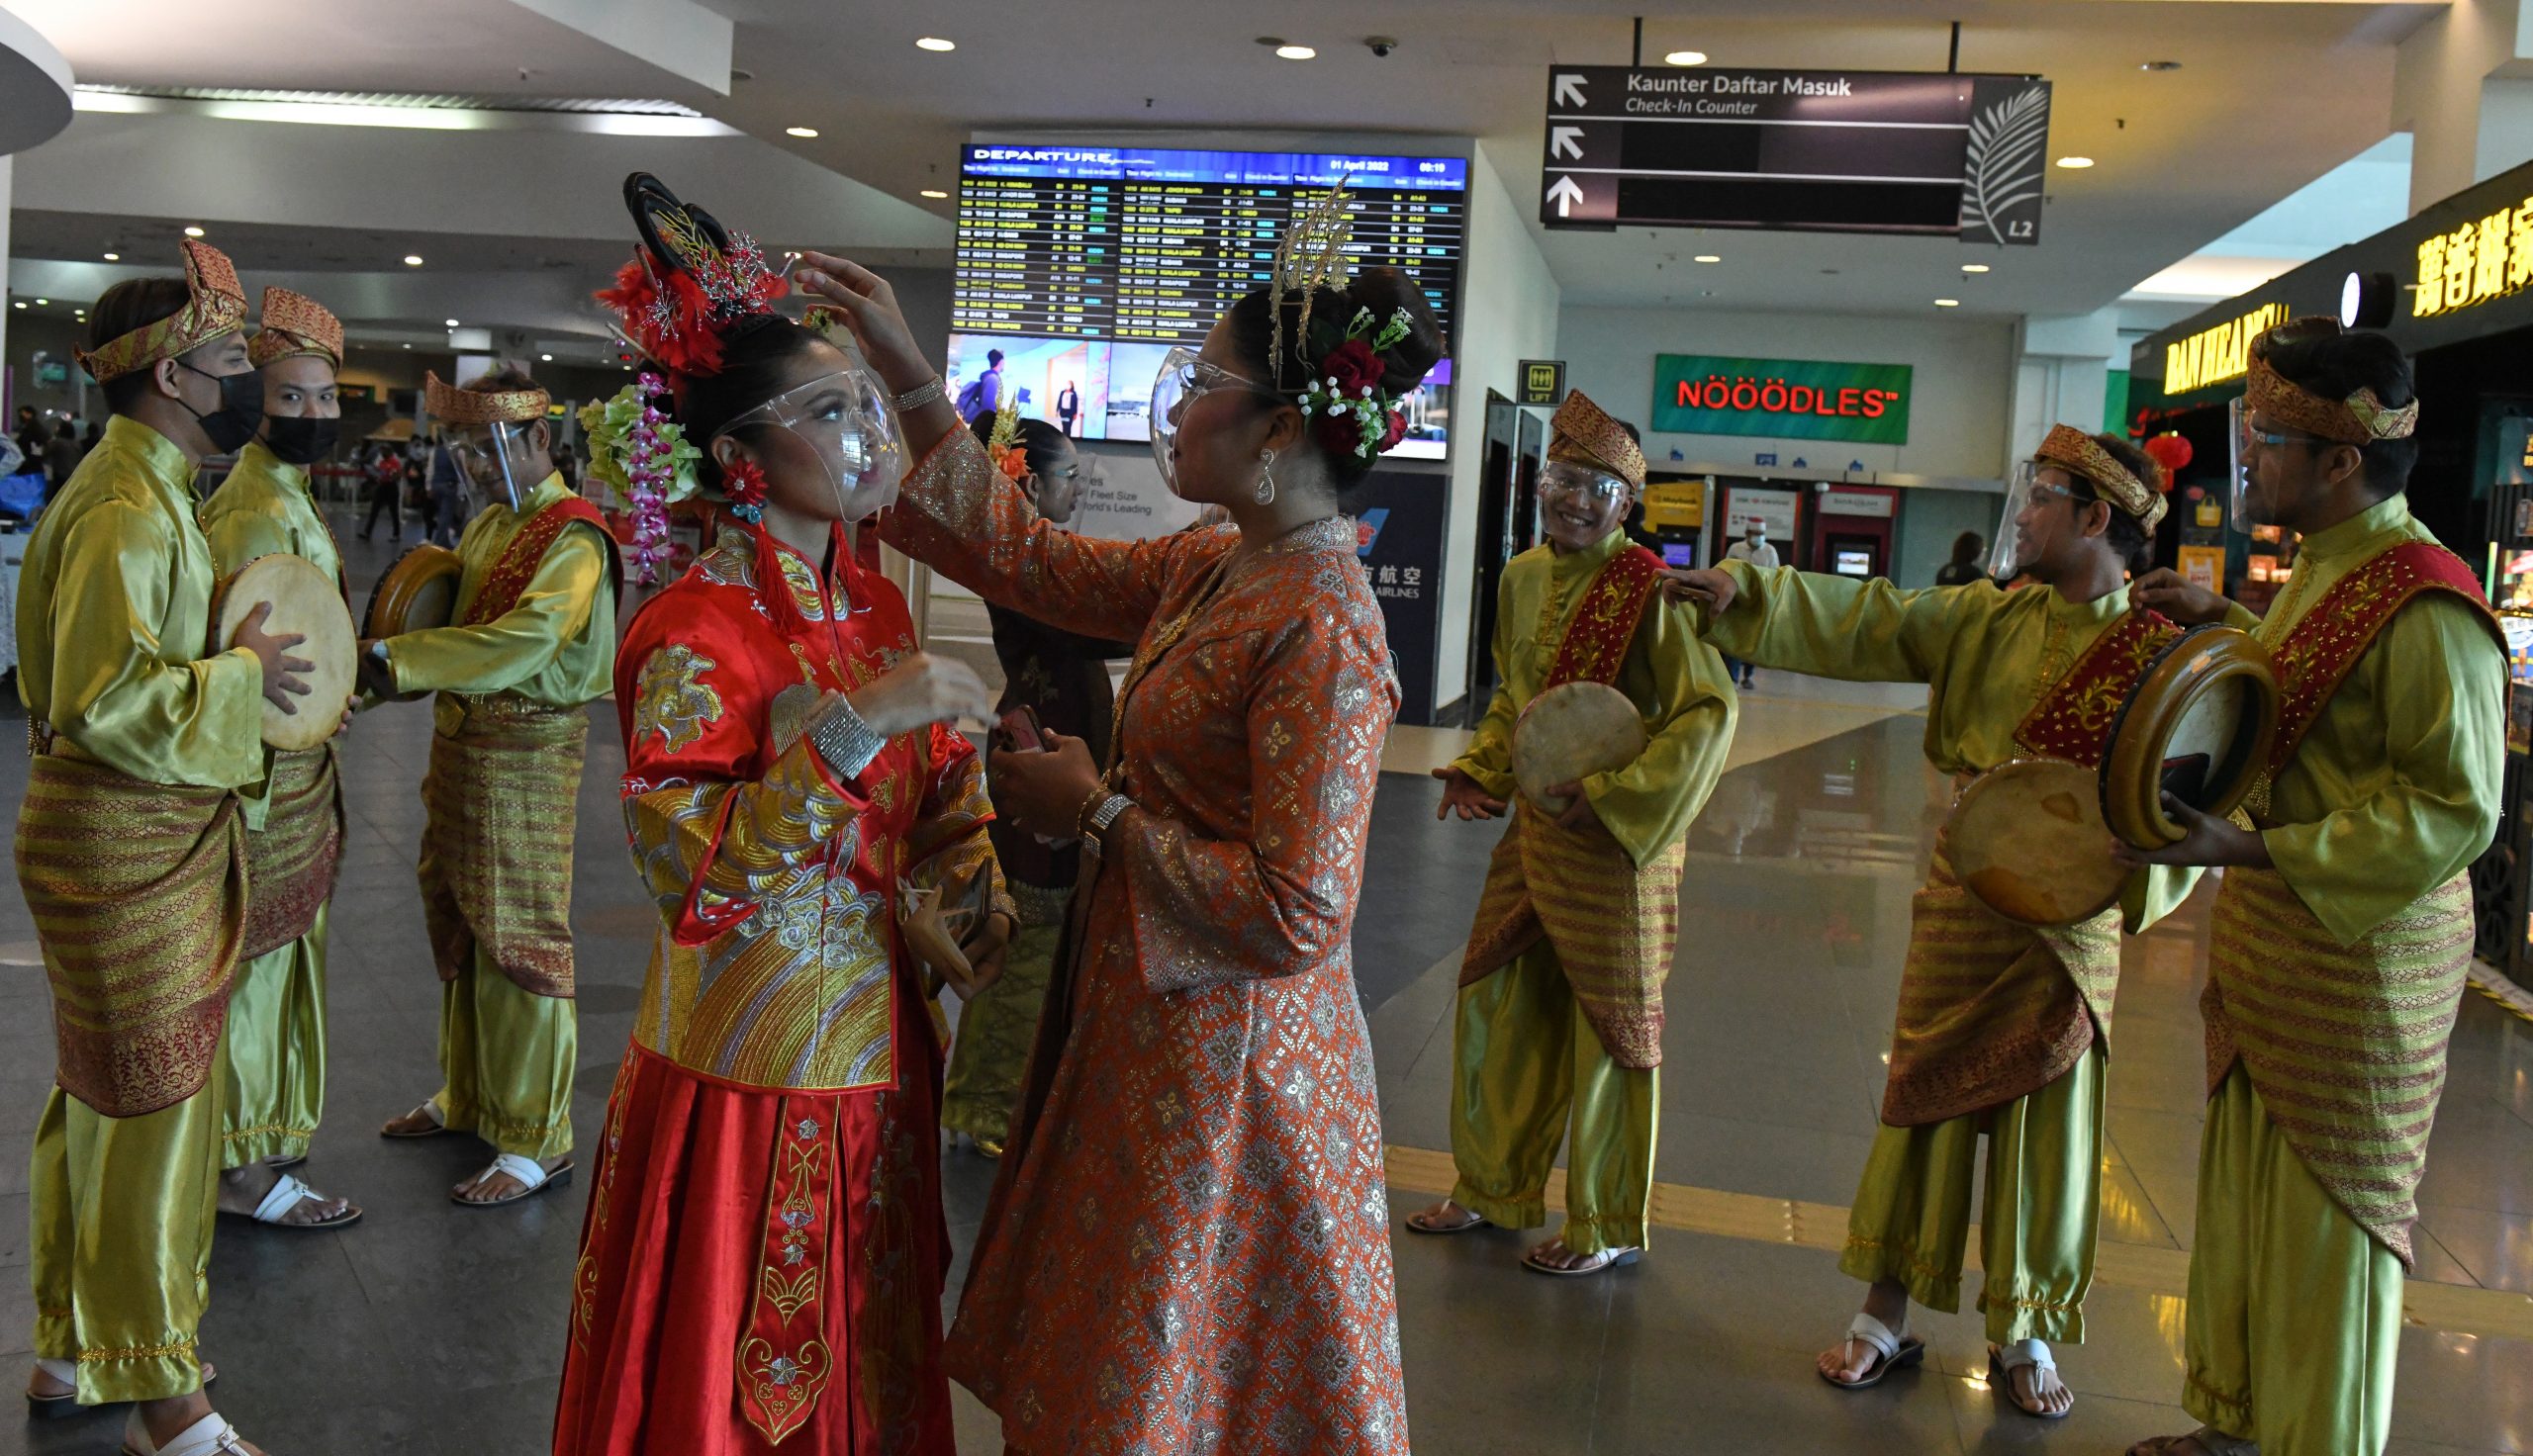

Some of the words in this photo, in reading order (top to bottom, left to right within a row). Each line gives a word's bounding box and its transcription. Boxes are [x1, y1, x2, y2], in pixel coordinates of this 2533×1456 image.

[1628, 74, 1708, 93] Kaunter
[1714, 75, 1778, 94] Daftar
[1784, 77, 1851, 97] Masuk
[1625, 97, 1692, 113] Check-In
[1696, 99, 1757, 115] Counter
[975, 149, 1111, 162] DEPARTURE
[1330, 160, 1342, 169] 01
[1343, 160, 1365, 172] April
[1366, 161, 1389, 171] 2022
[2009, 221, 2032, 237] L2
[1529, 393, 1550, 403] LIFT
[1090, 490, 1114, 500] Fleet
[1116, 491, 1138, 501] Size
[1114, 502, 1152, 515] Leading
[1375, 587, 1419, 598] AIRLINES
